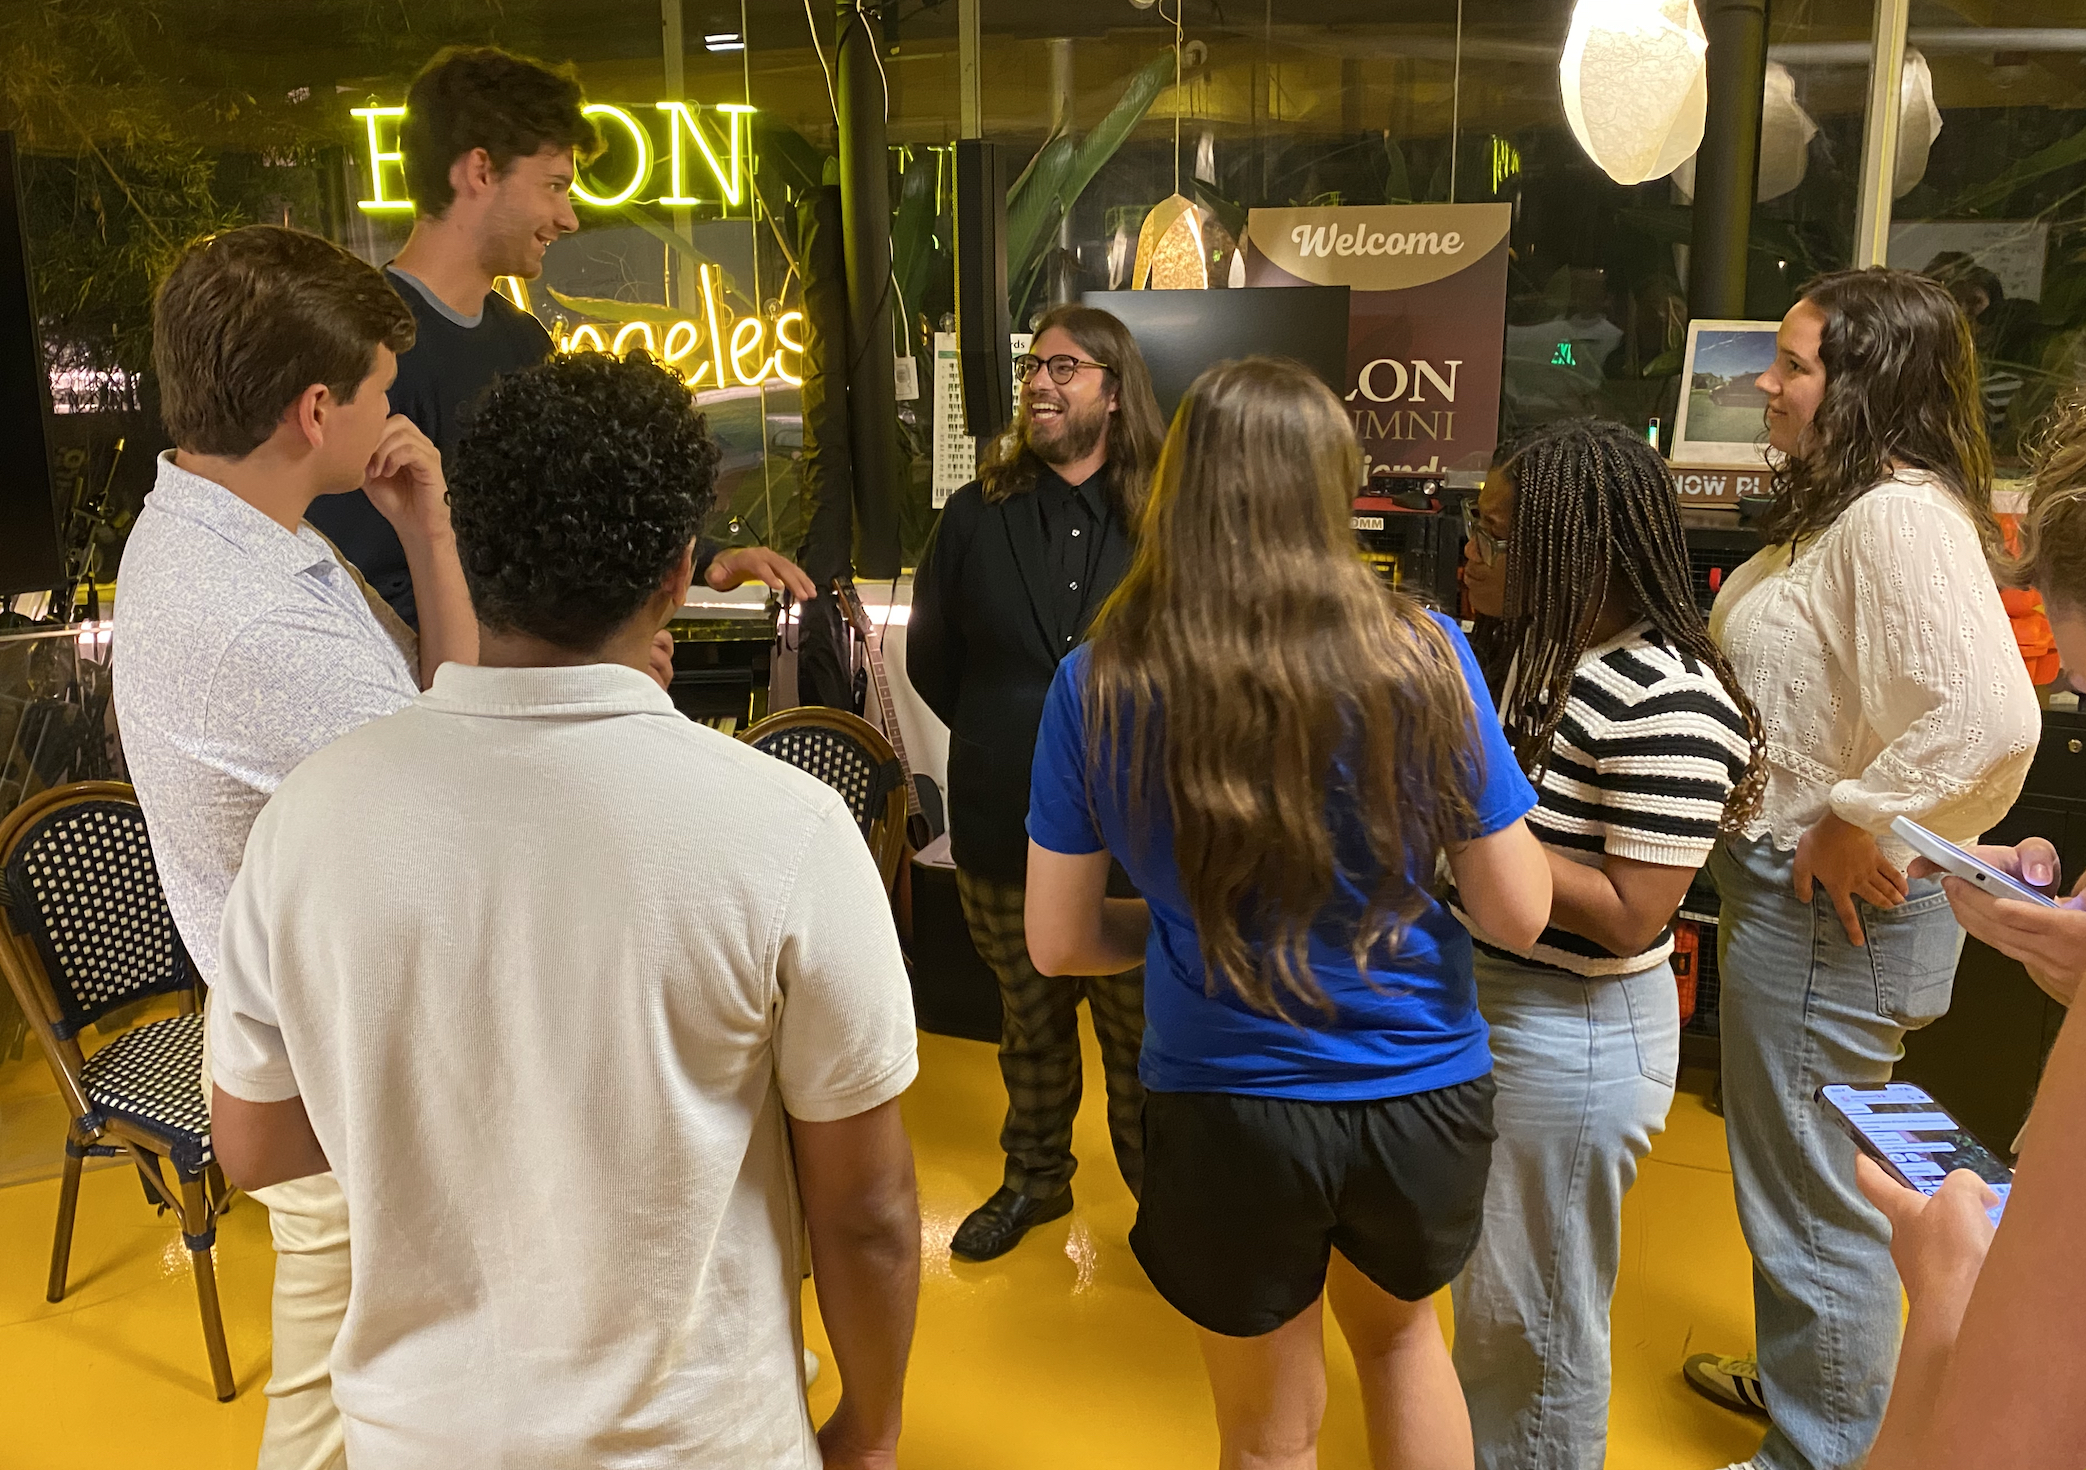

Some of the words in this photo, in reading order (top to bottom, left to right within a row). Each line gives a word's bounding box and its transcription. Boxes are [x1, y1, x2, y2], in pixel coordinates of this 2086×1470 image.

[349, 100, 757, 208] EON
[1291, 222, 1465, 258] Welcome
[1345, 358, 1463, 403] ON
